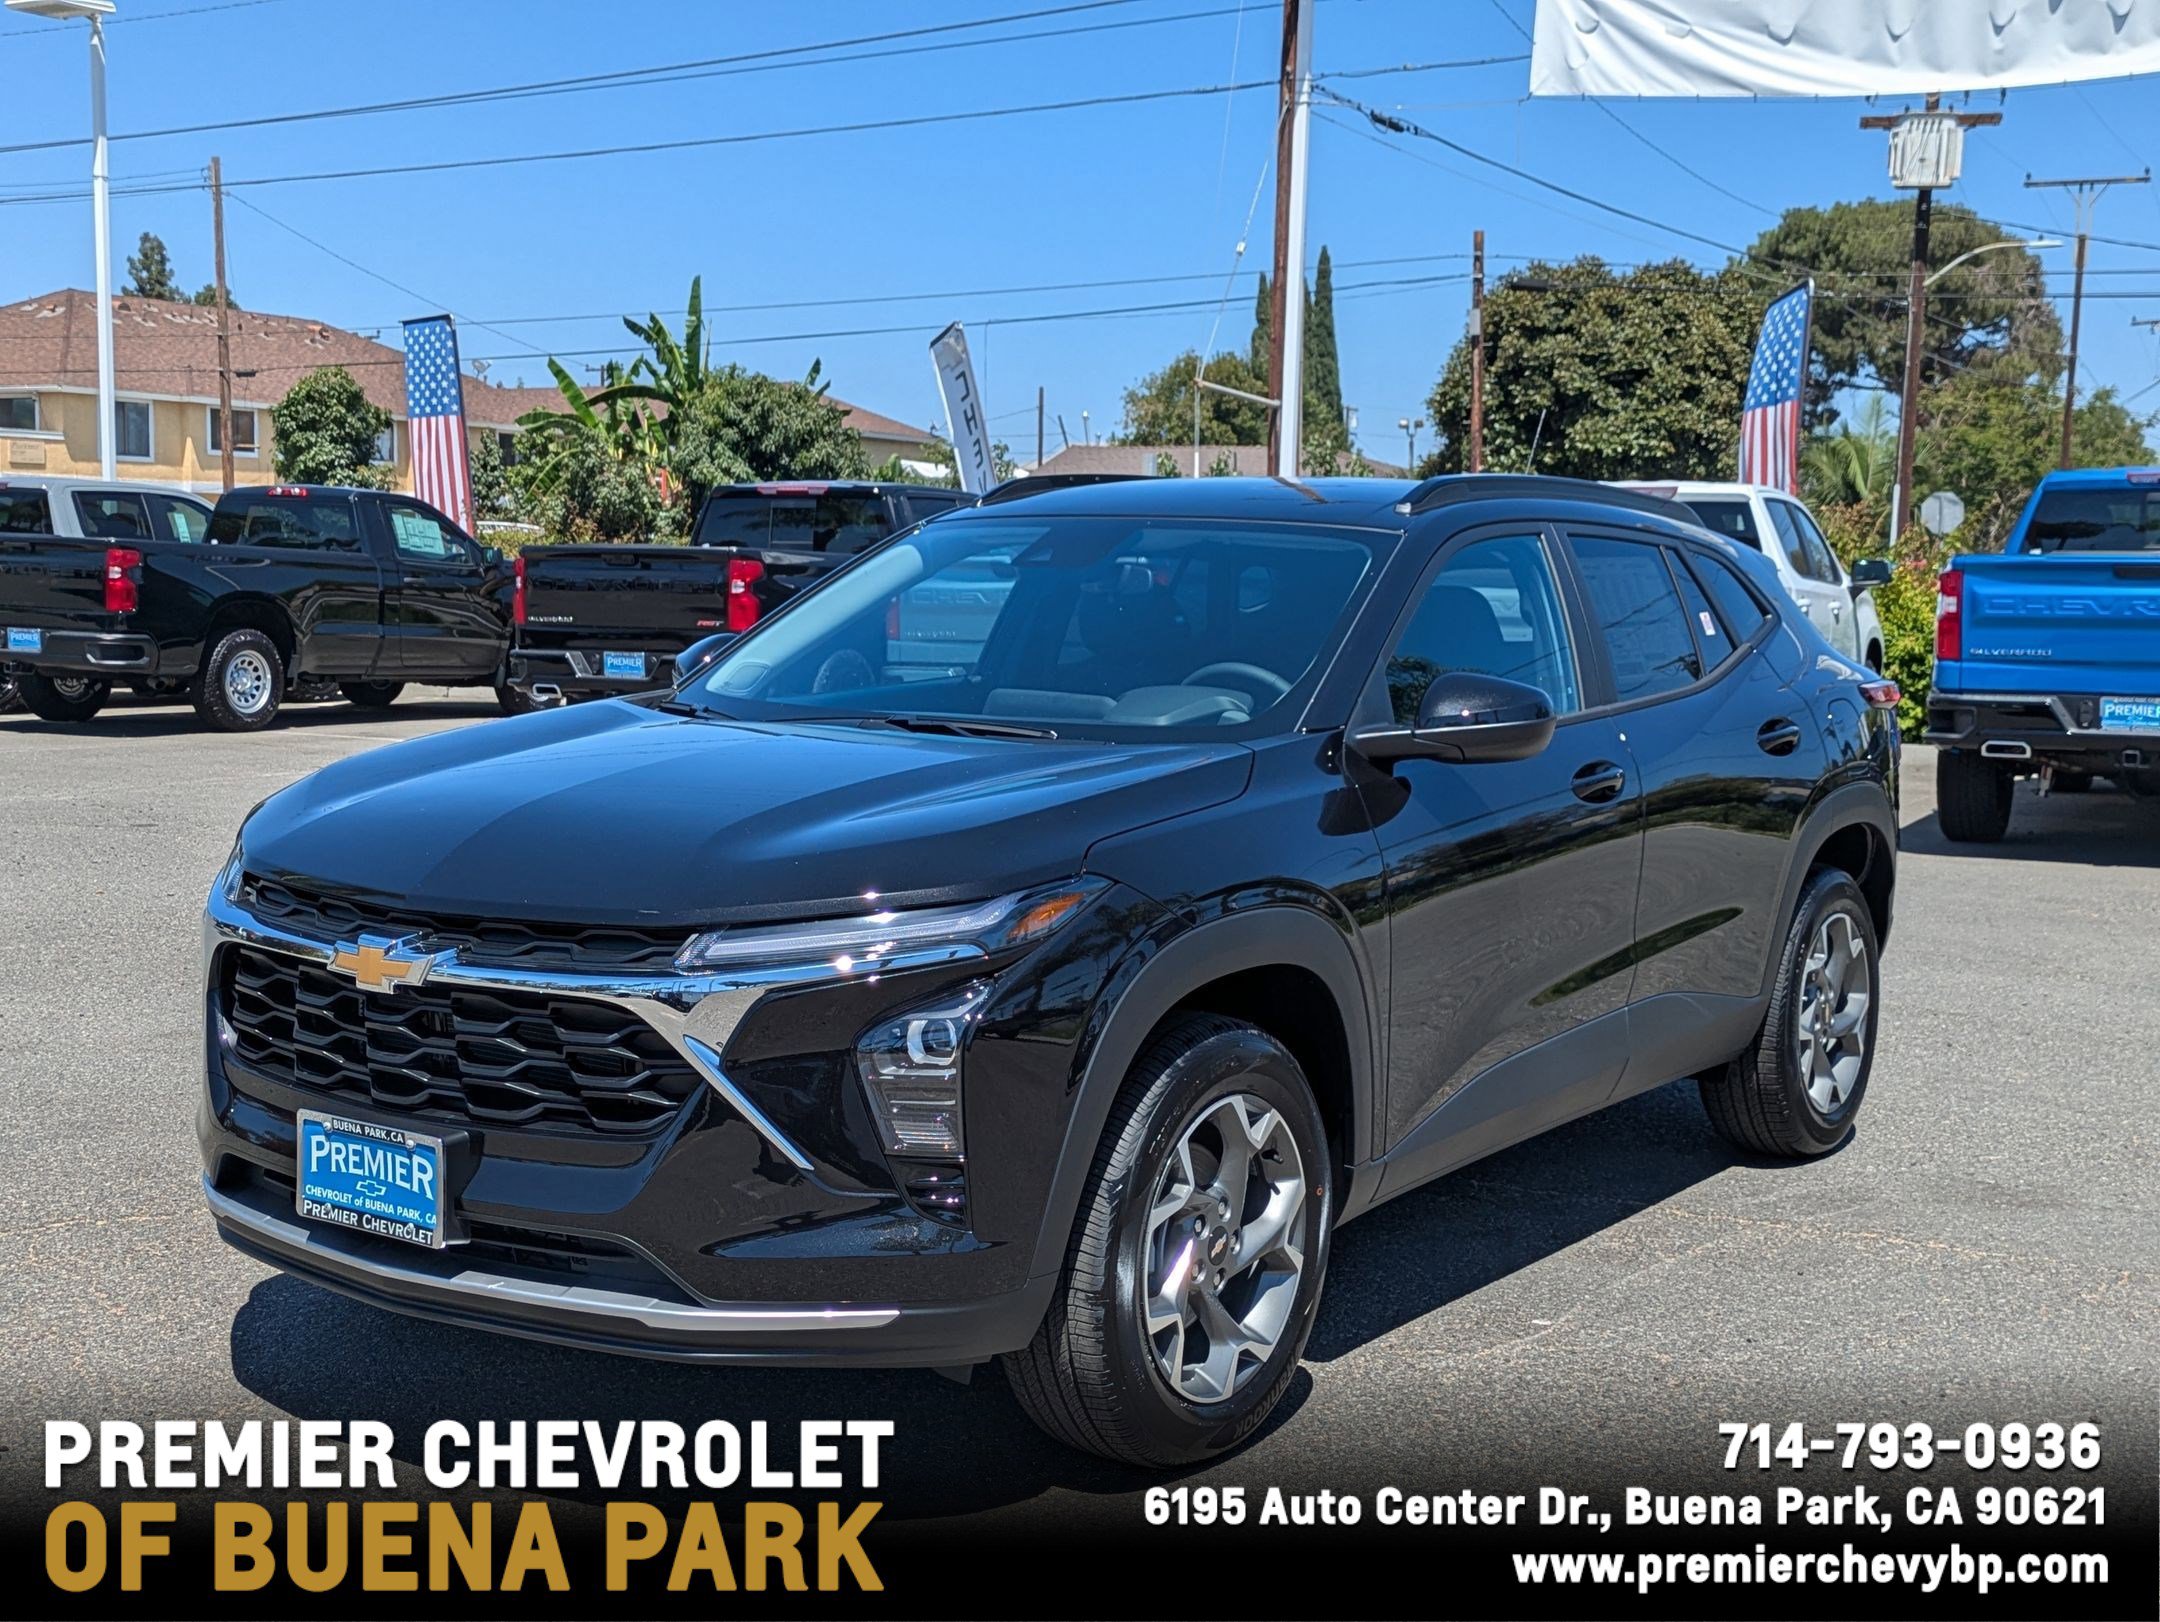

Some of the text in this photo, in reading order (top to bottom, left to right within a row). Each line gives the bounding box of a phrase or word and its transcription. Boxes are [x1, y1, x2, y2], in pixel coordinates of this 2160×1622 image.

[607, 656, 642, 669] PREMIER
[332, 1119, 363, 1135] BUENA
[310, 1134, 434, 1201] PREMIER
[303, 1199, 433, 1245] PREMIER CHEVROLET
[305, 1184, 437, 1225] CHEVROLET of BUENA PARK, CA
